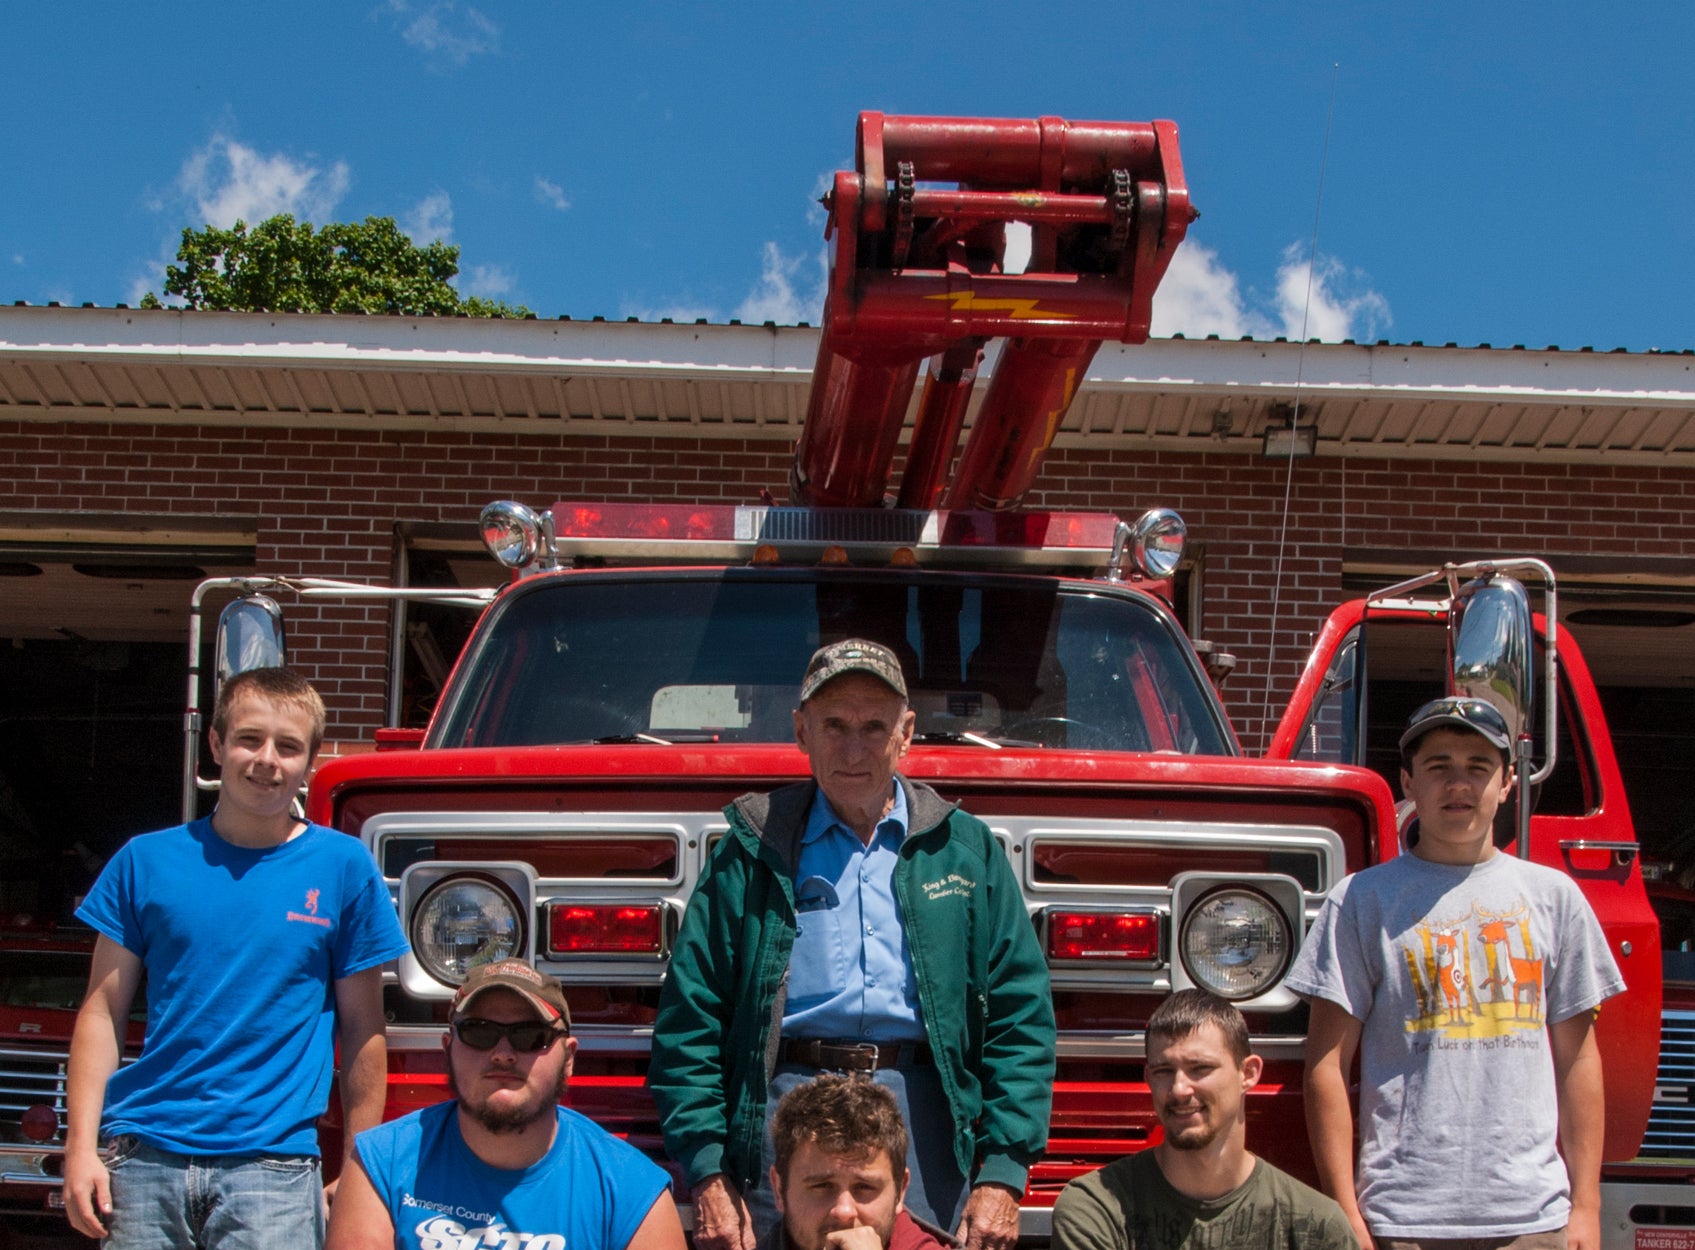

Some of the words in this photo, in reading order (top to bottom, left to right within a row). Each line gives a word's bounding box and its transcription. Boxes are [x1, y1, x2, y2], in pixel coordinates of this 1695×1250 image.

[402, 1193, 453, 1215] Somerset
[455, 1206, 496, 1225] County
[1637, 1238, 1671, 1249] TANKER
